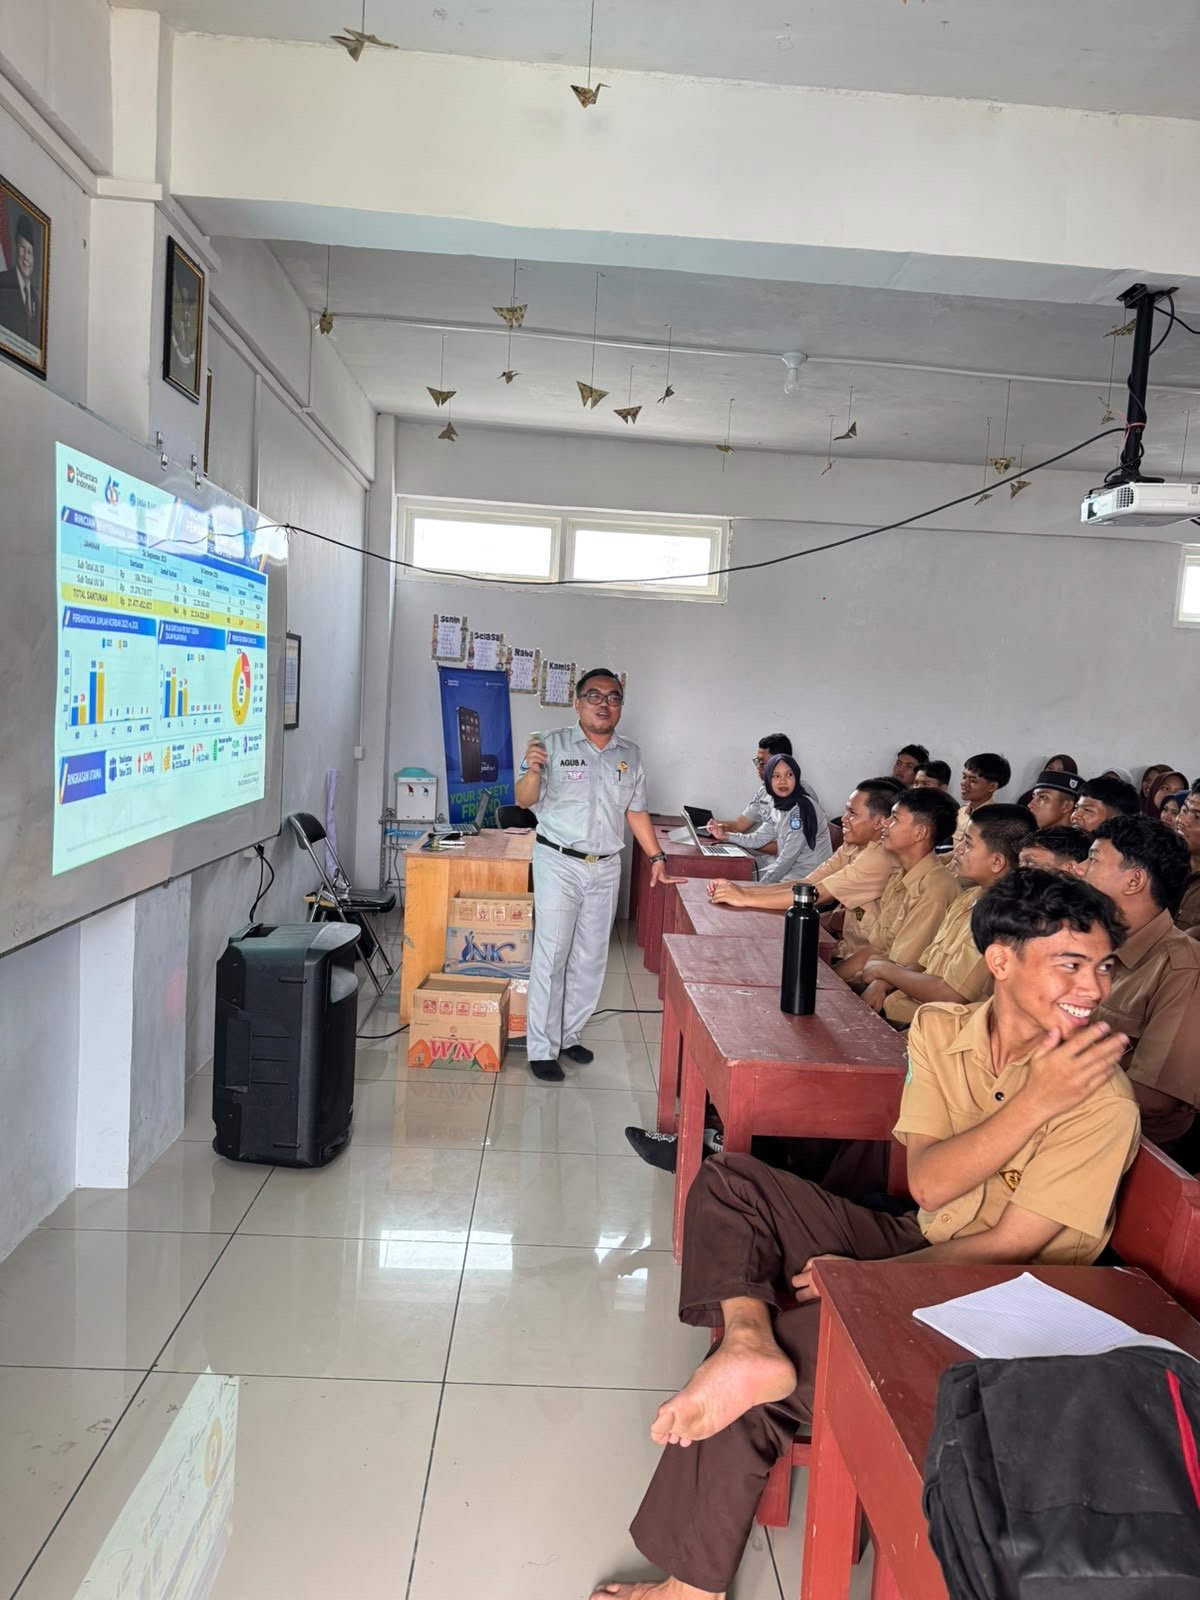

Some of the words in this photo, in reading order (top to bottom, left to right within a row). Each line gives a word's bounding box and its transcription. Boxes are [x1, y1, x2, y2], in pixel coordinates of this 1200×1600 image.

[76, 477, 97, 493] Indonesia
[549, 662, 571, 671] Kamis
[560, 759, 580, 767] AGUS
[581, 759, 588, 767] A.
[449, 790, 475, 805] YOUR
[461, 798, 501, 819] FRIND
